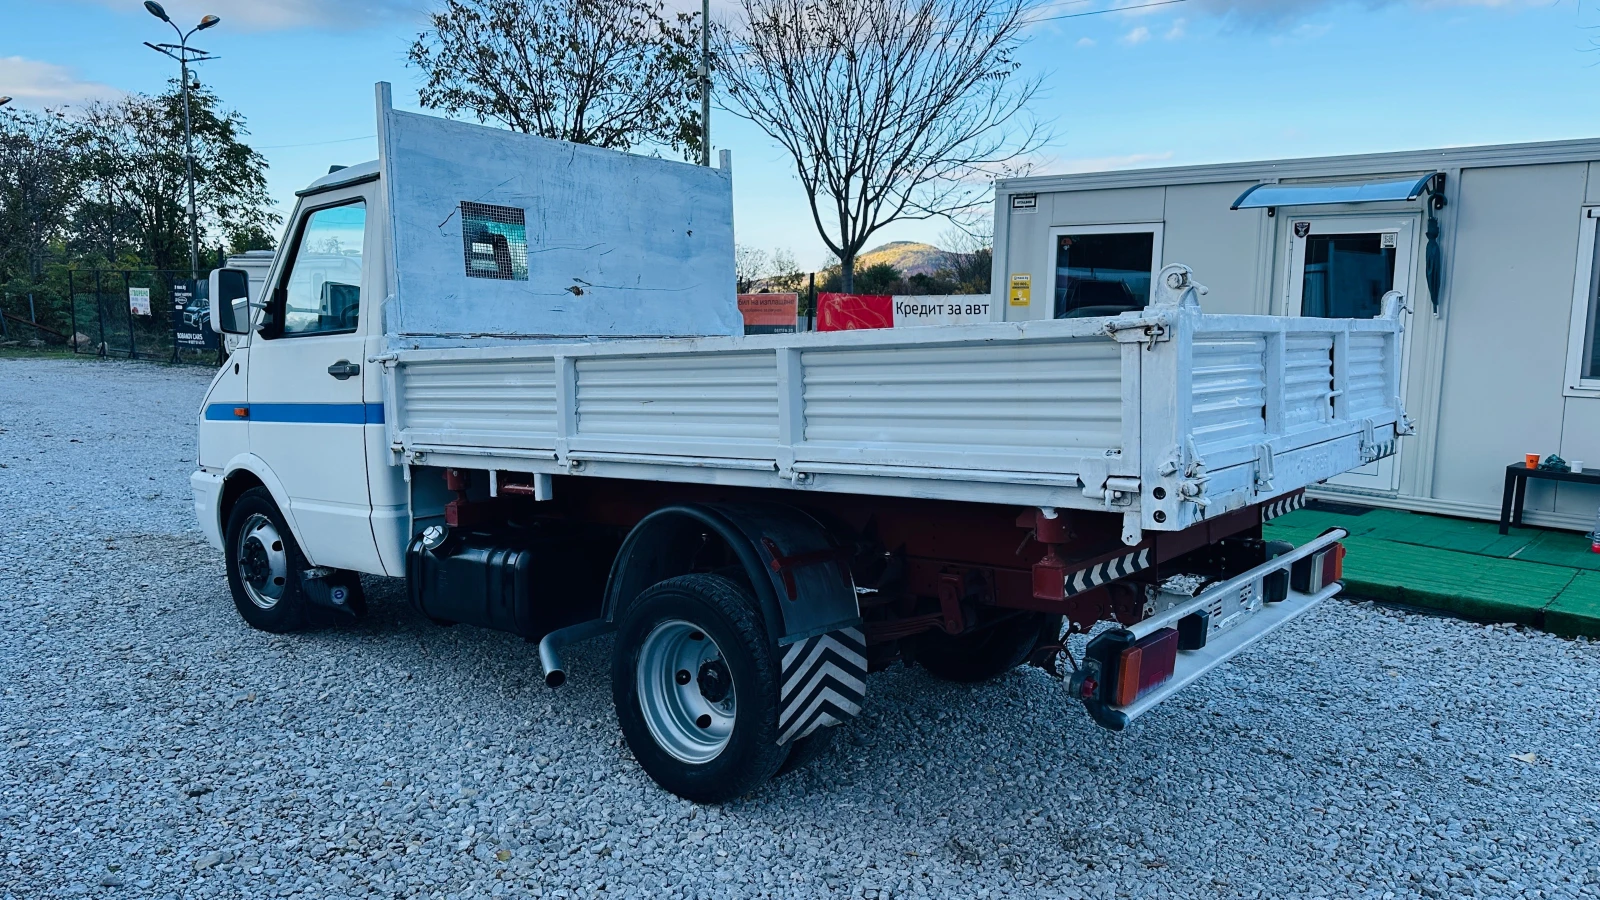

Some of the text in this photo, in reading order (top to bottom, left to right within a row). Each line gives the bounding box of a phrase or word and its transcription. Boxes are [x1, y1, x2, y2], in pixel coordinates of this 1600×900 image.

[896, 302, 989, 317] Кредит за авт
